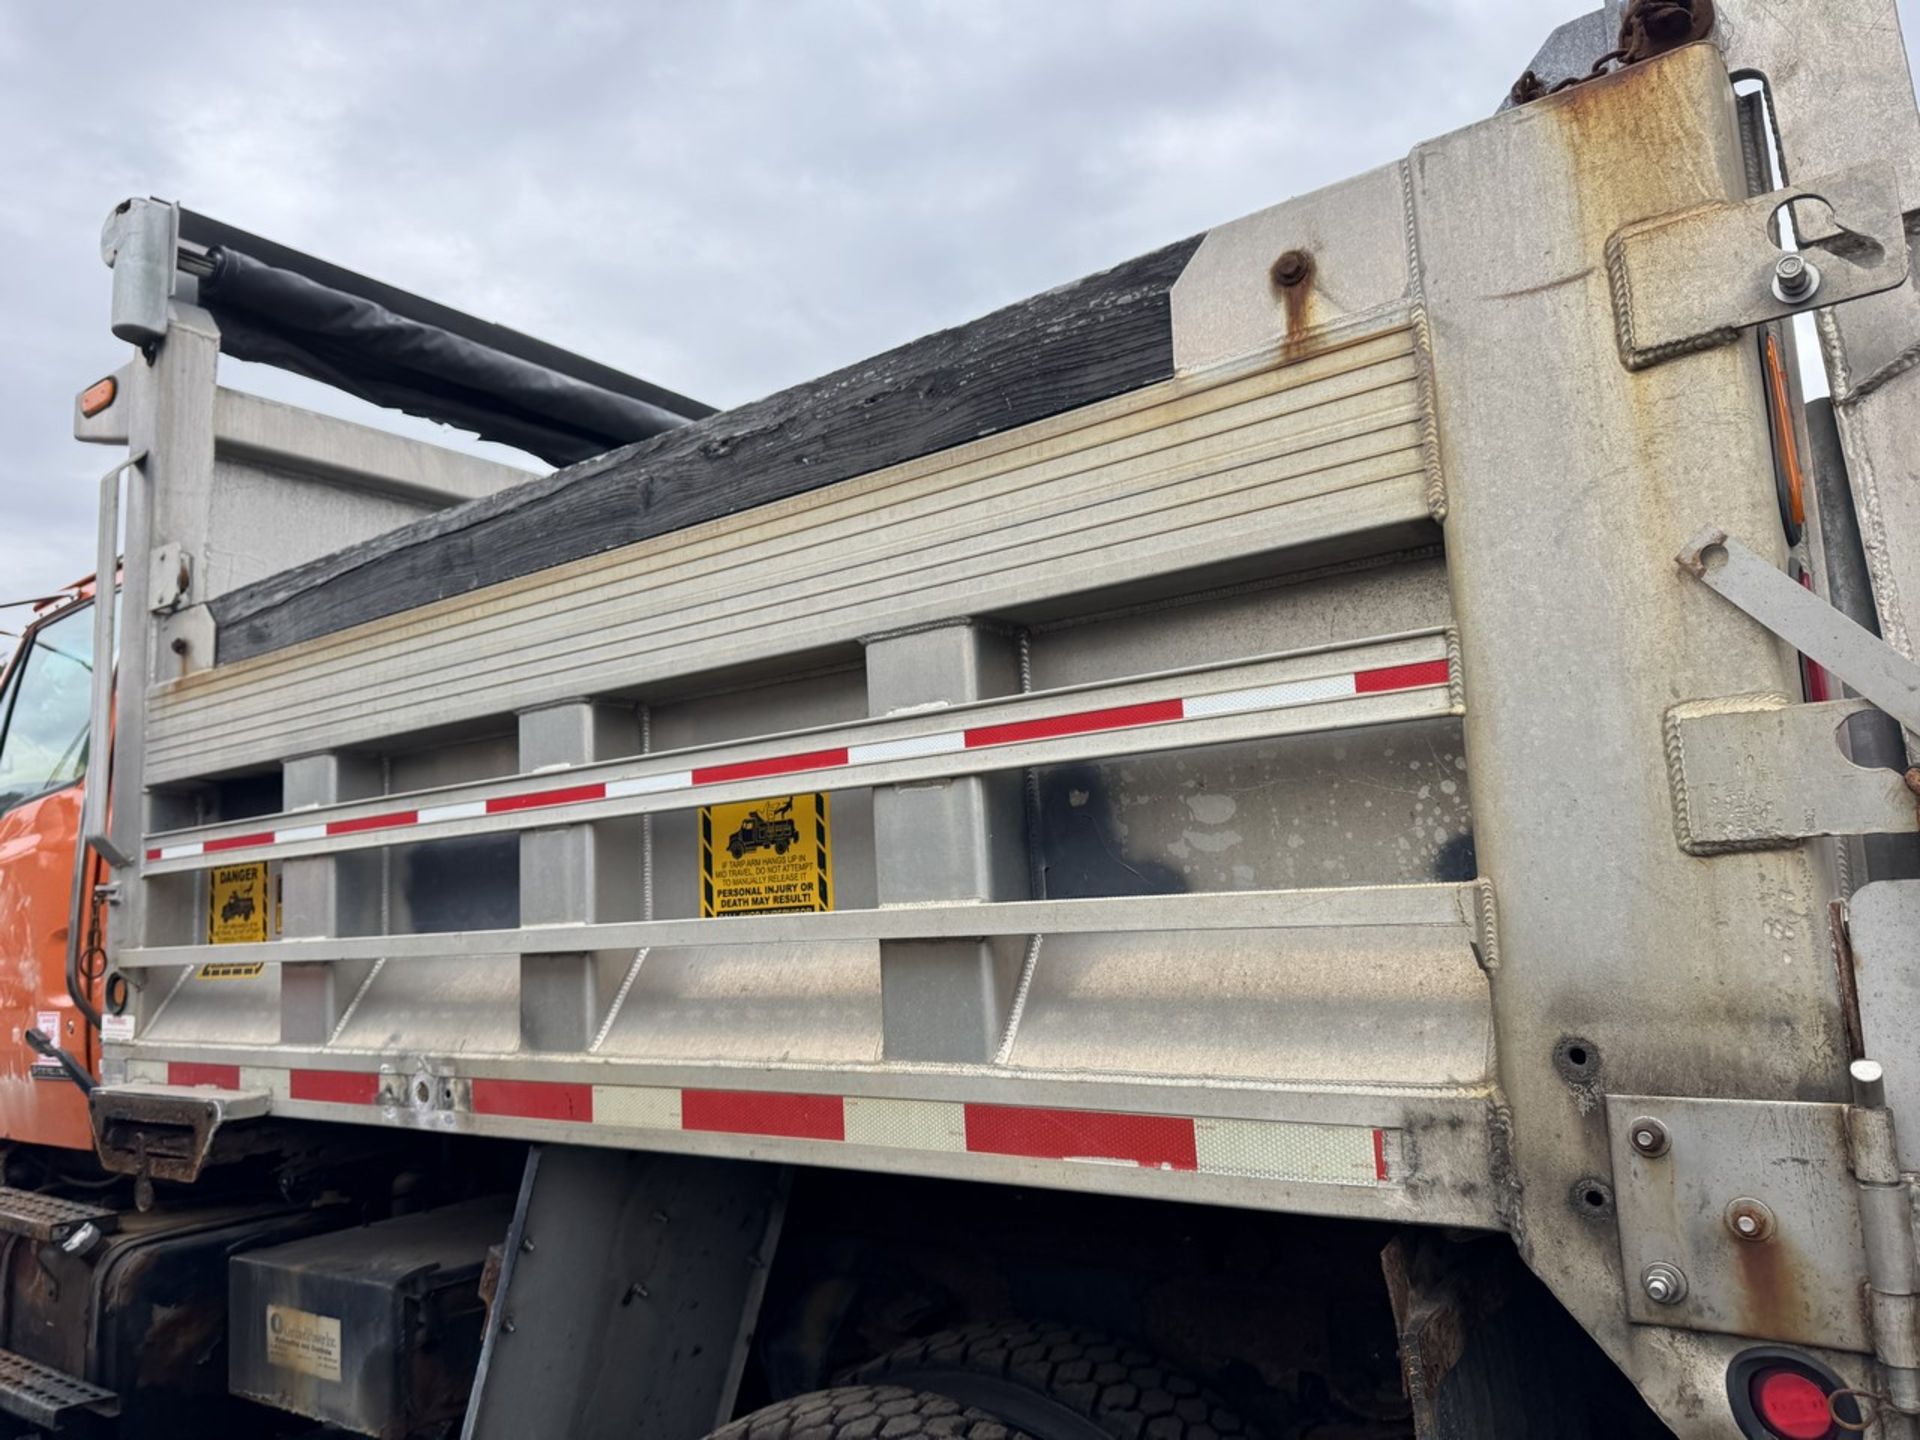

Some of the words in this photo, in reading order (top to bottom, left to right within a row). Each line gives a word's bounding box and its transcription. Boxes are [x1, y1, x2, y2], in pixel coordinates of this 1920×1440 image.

[729, 859, 745, 868] TARP
[747, 858, 762, 866] ARM
[762, 856, 786, 865] HANGS
[787, 855, 798, 864] UP
[220, 868, 258, 884] DANGER
[716, 870, 728, 878] MID
[756, 866, 766, 875] DO
[768, 865, 780, 874] NOT
[782, 862, 813, 872] ATTEMPT
[732, 876, 766, 886] MANUALLY
[768, 874, 799, 883] RELEASE
[800, 873, 807, 881] IT
[717, 887, 762, 898] PERSONAL
[764, 884, 797, 894] INJURY
[800, 882, 814, 891] OR
[721, 898, 750, 908] DEATH
[752, 896, 770, 906] MAY
[773, 893, 811, 904] RESULT!
